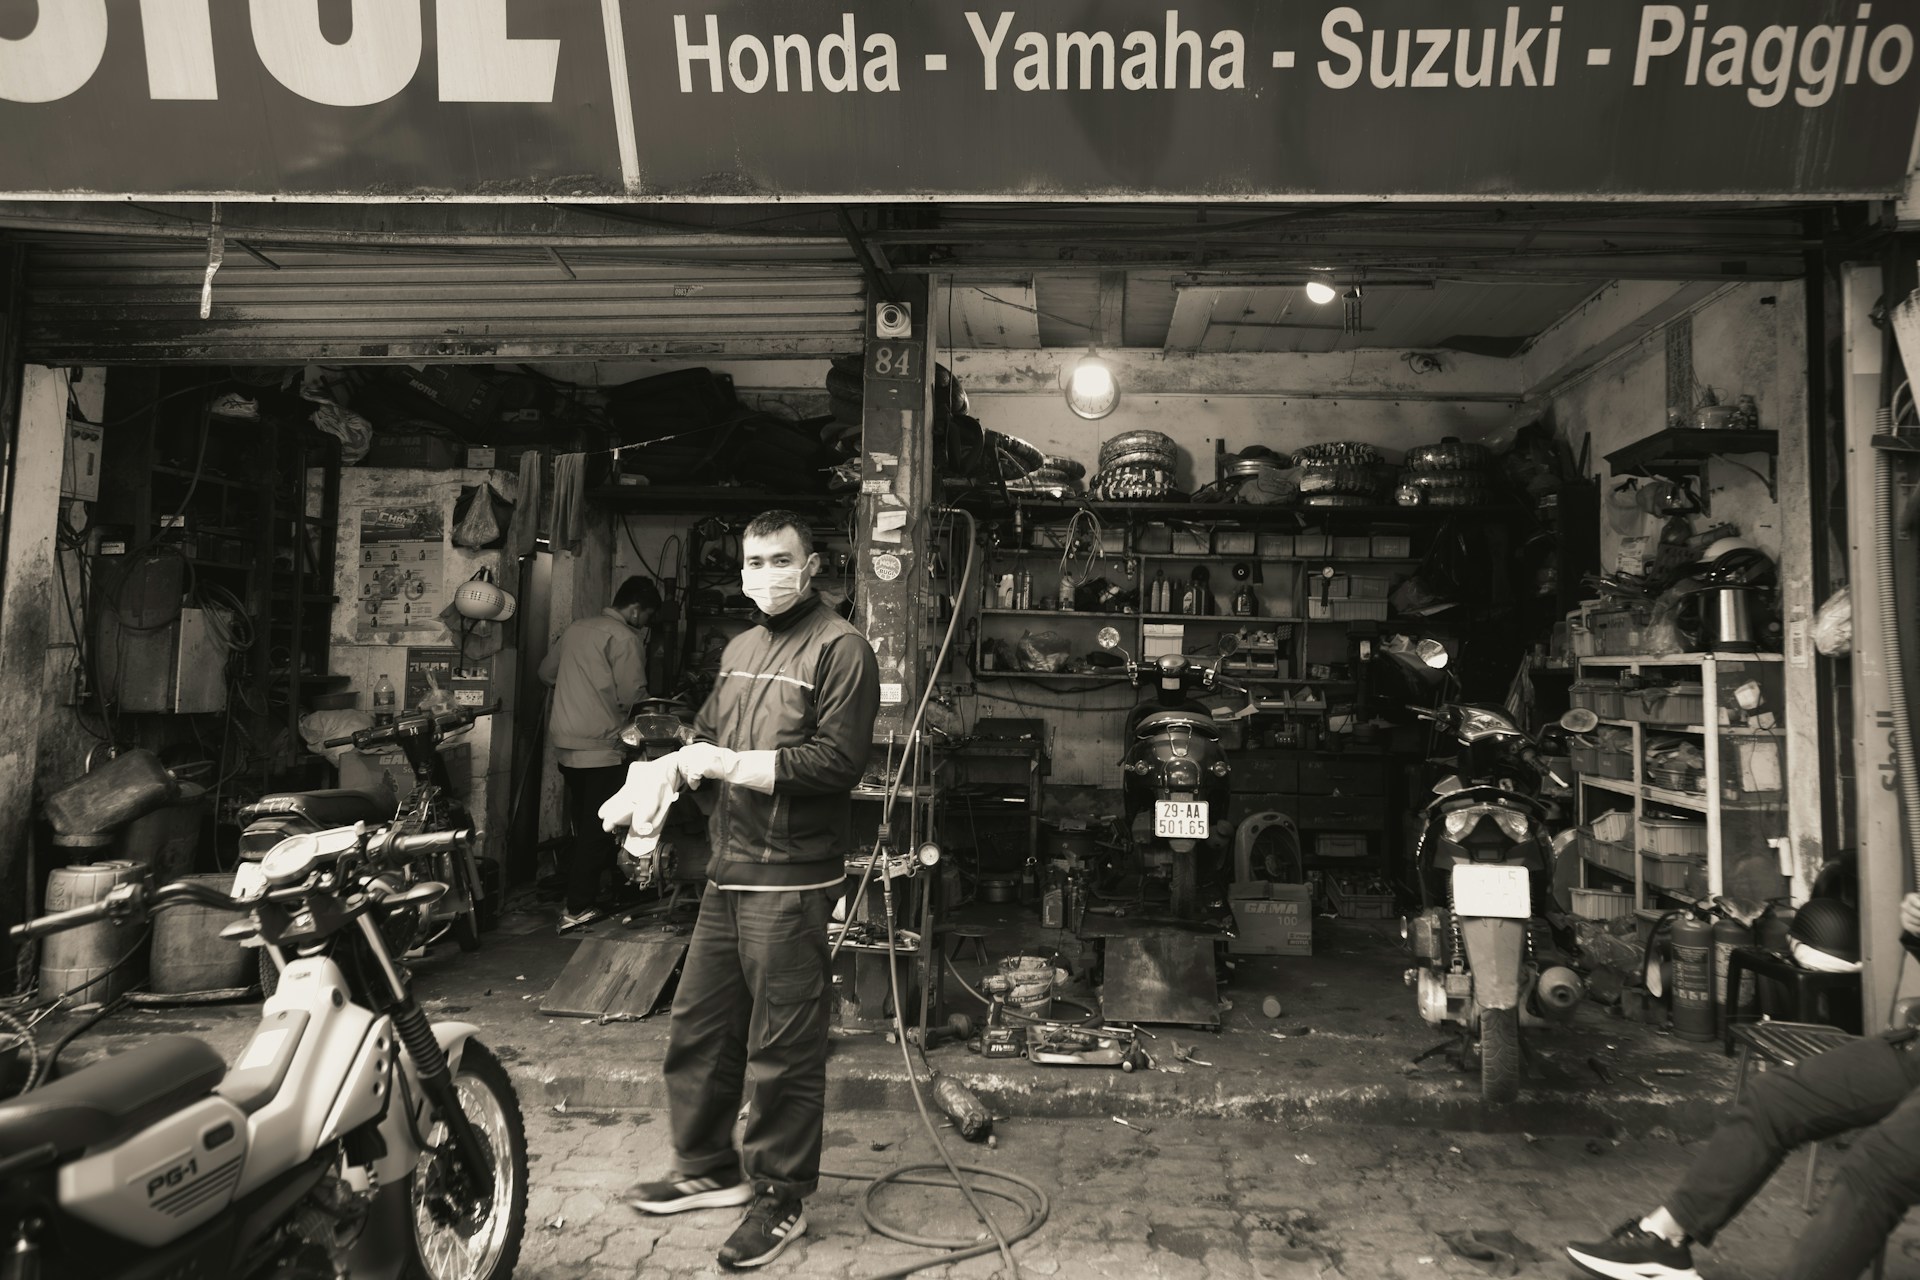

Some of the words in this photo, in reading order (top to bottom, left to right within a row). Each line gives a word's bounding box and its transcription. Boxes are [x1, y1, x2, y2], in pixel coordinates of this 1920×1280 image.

[673, 13, 901, 94] Honda
[964, 9, 1246, 92] Yamaha
[1317, 6, 1564, 90] Suzuki
[1633, 3, 1913, 108] Piaggio
[875, 347, 910, 376] 84
[409, 379, 438, 398] MOTUL
[1164, 803, 1200, 818] 29-AA
[1159, 819, 1205, 836] 501.65
[1244, 903, 1298, 915] GAMA
[1277, 916, 1298, 926] 100
[146, 1157, 198, 1199] PG-1
